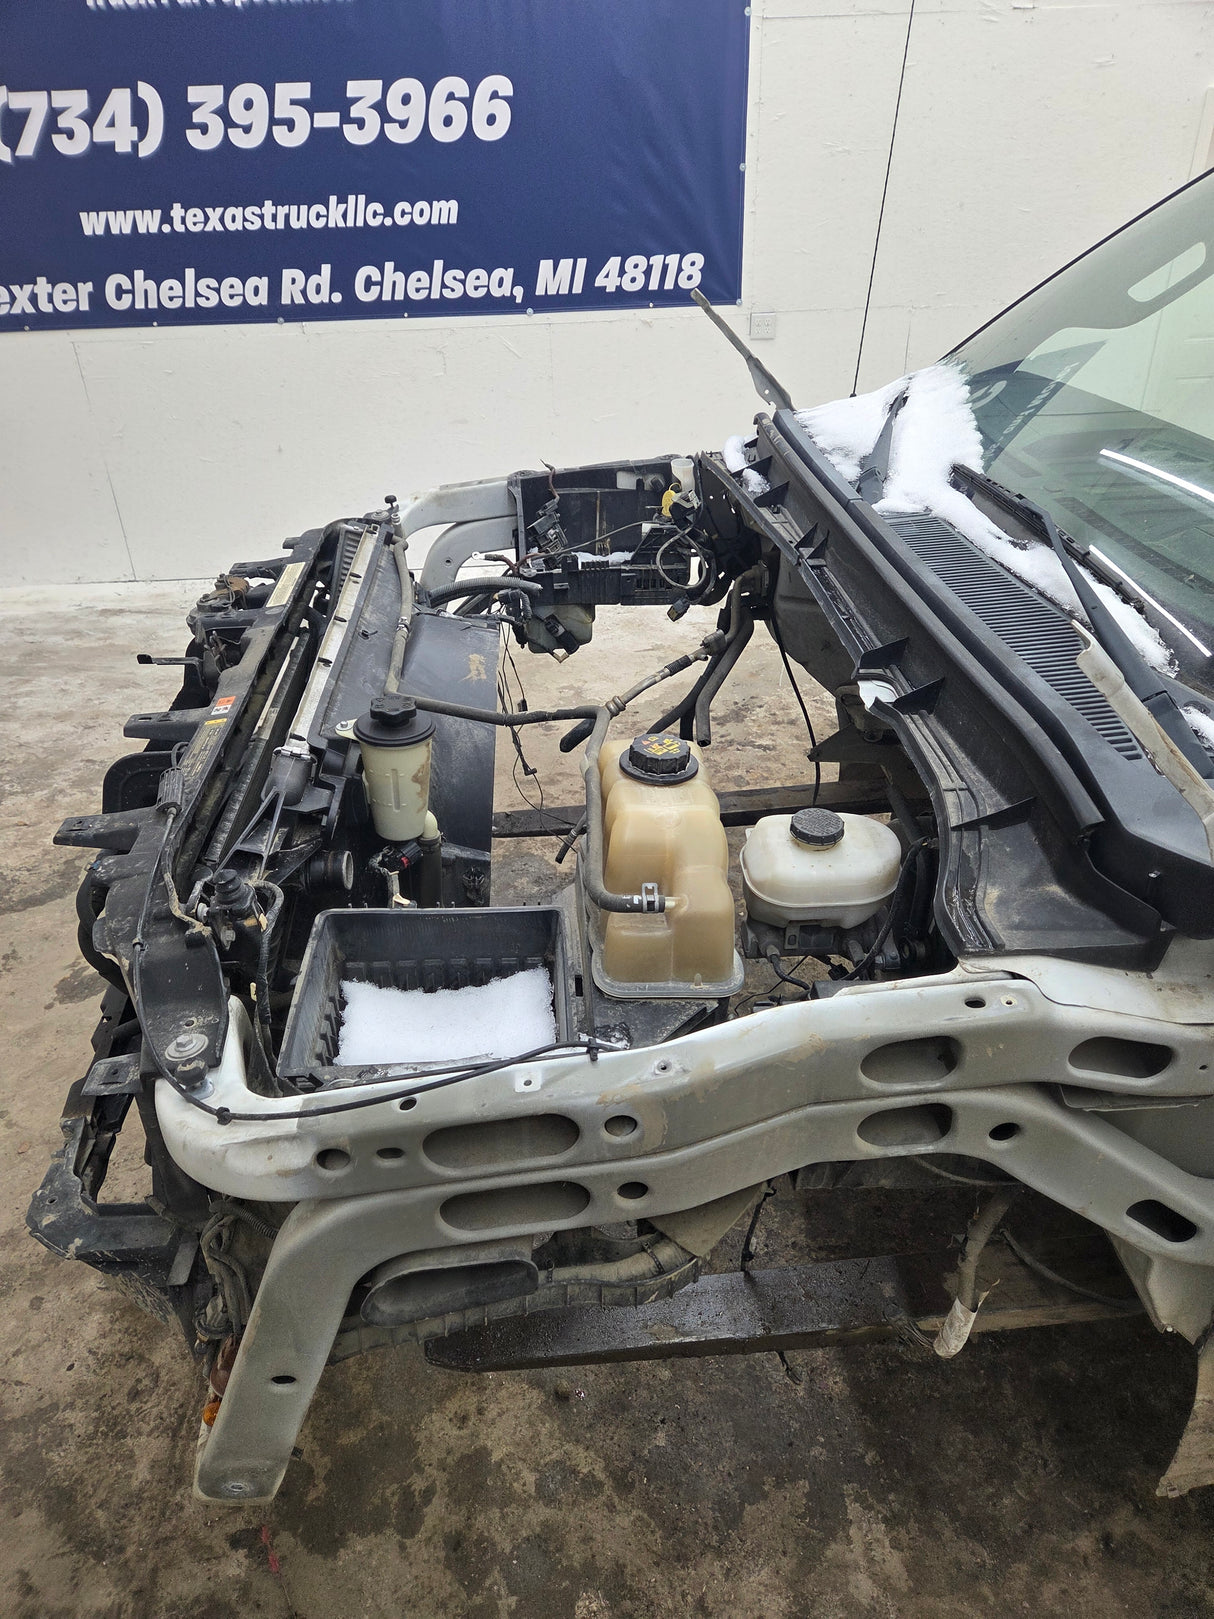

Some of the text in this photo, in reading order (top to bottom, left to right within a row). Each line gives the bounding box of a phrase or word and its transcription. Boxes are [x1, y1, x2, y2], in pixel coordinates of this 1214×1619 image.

[186, 74, 514, 151] 395-3966
[79, 194, 459, 236] www.texastruckllc.com
[105, 268, 269, 311] Chelsea
[280, 263, 343, 305] Rd.
[354, 258, 524, 304] Chelsea,
[534, 257, 588, 296] MI
[594, 252, 705, 293] 48118
